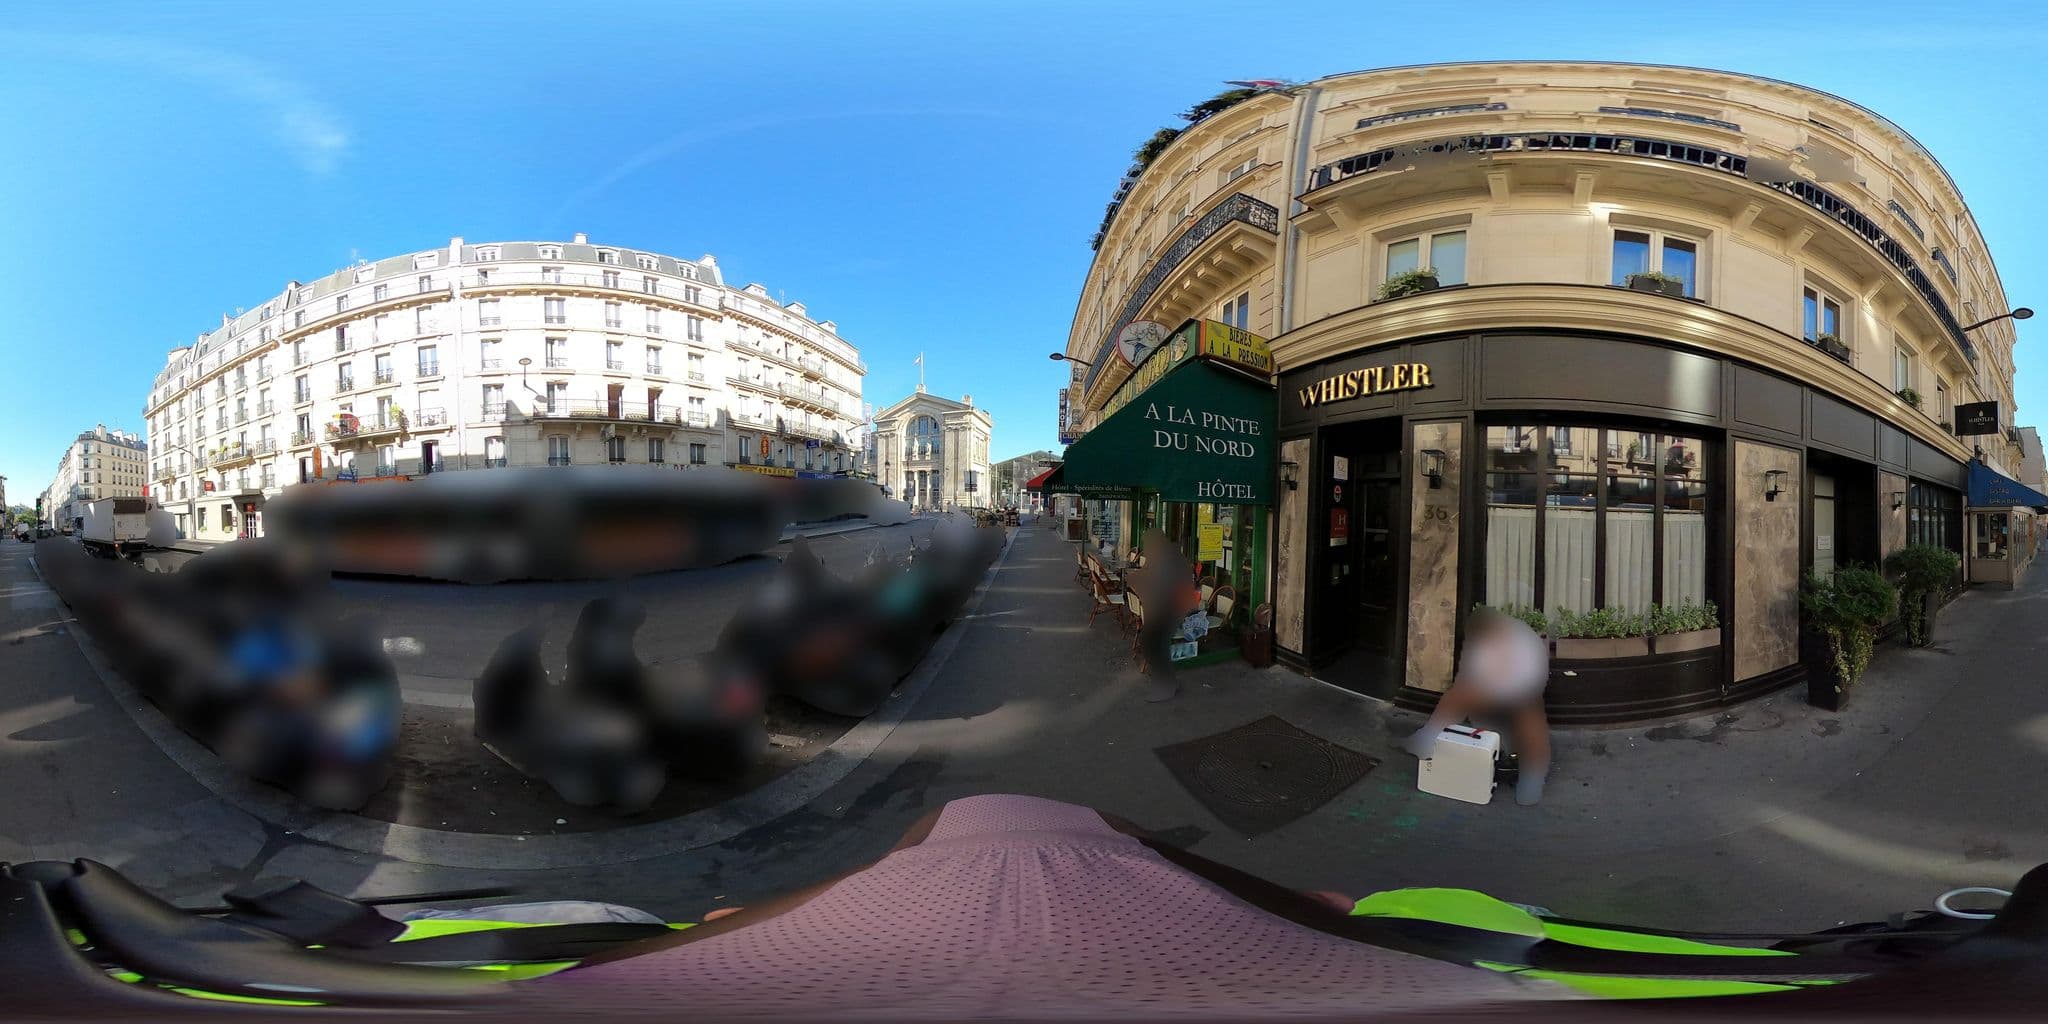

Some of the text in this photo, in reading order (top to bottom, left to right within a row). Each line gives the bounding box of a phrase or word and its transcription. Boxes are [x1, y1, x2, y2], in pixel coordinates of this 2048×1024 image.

[1209, 343, 1268, 369] A LA PRESSION
[1298, 363, 1433, 408] WHISTLER
[1144, 402, 1161, 420] A
[1167, 405, 1197, 426] LA
[1201, 411, 1261, 436] PINTE
[1153, 430, 1255, 458] DU NORD
[1198, 478, 1256, 499] HÔTEL
